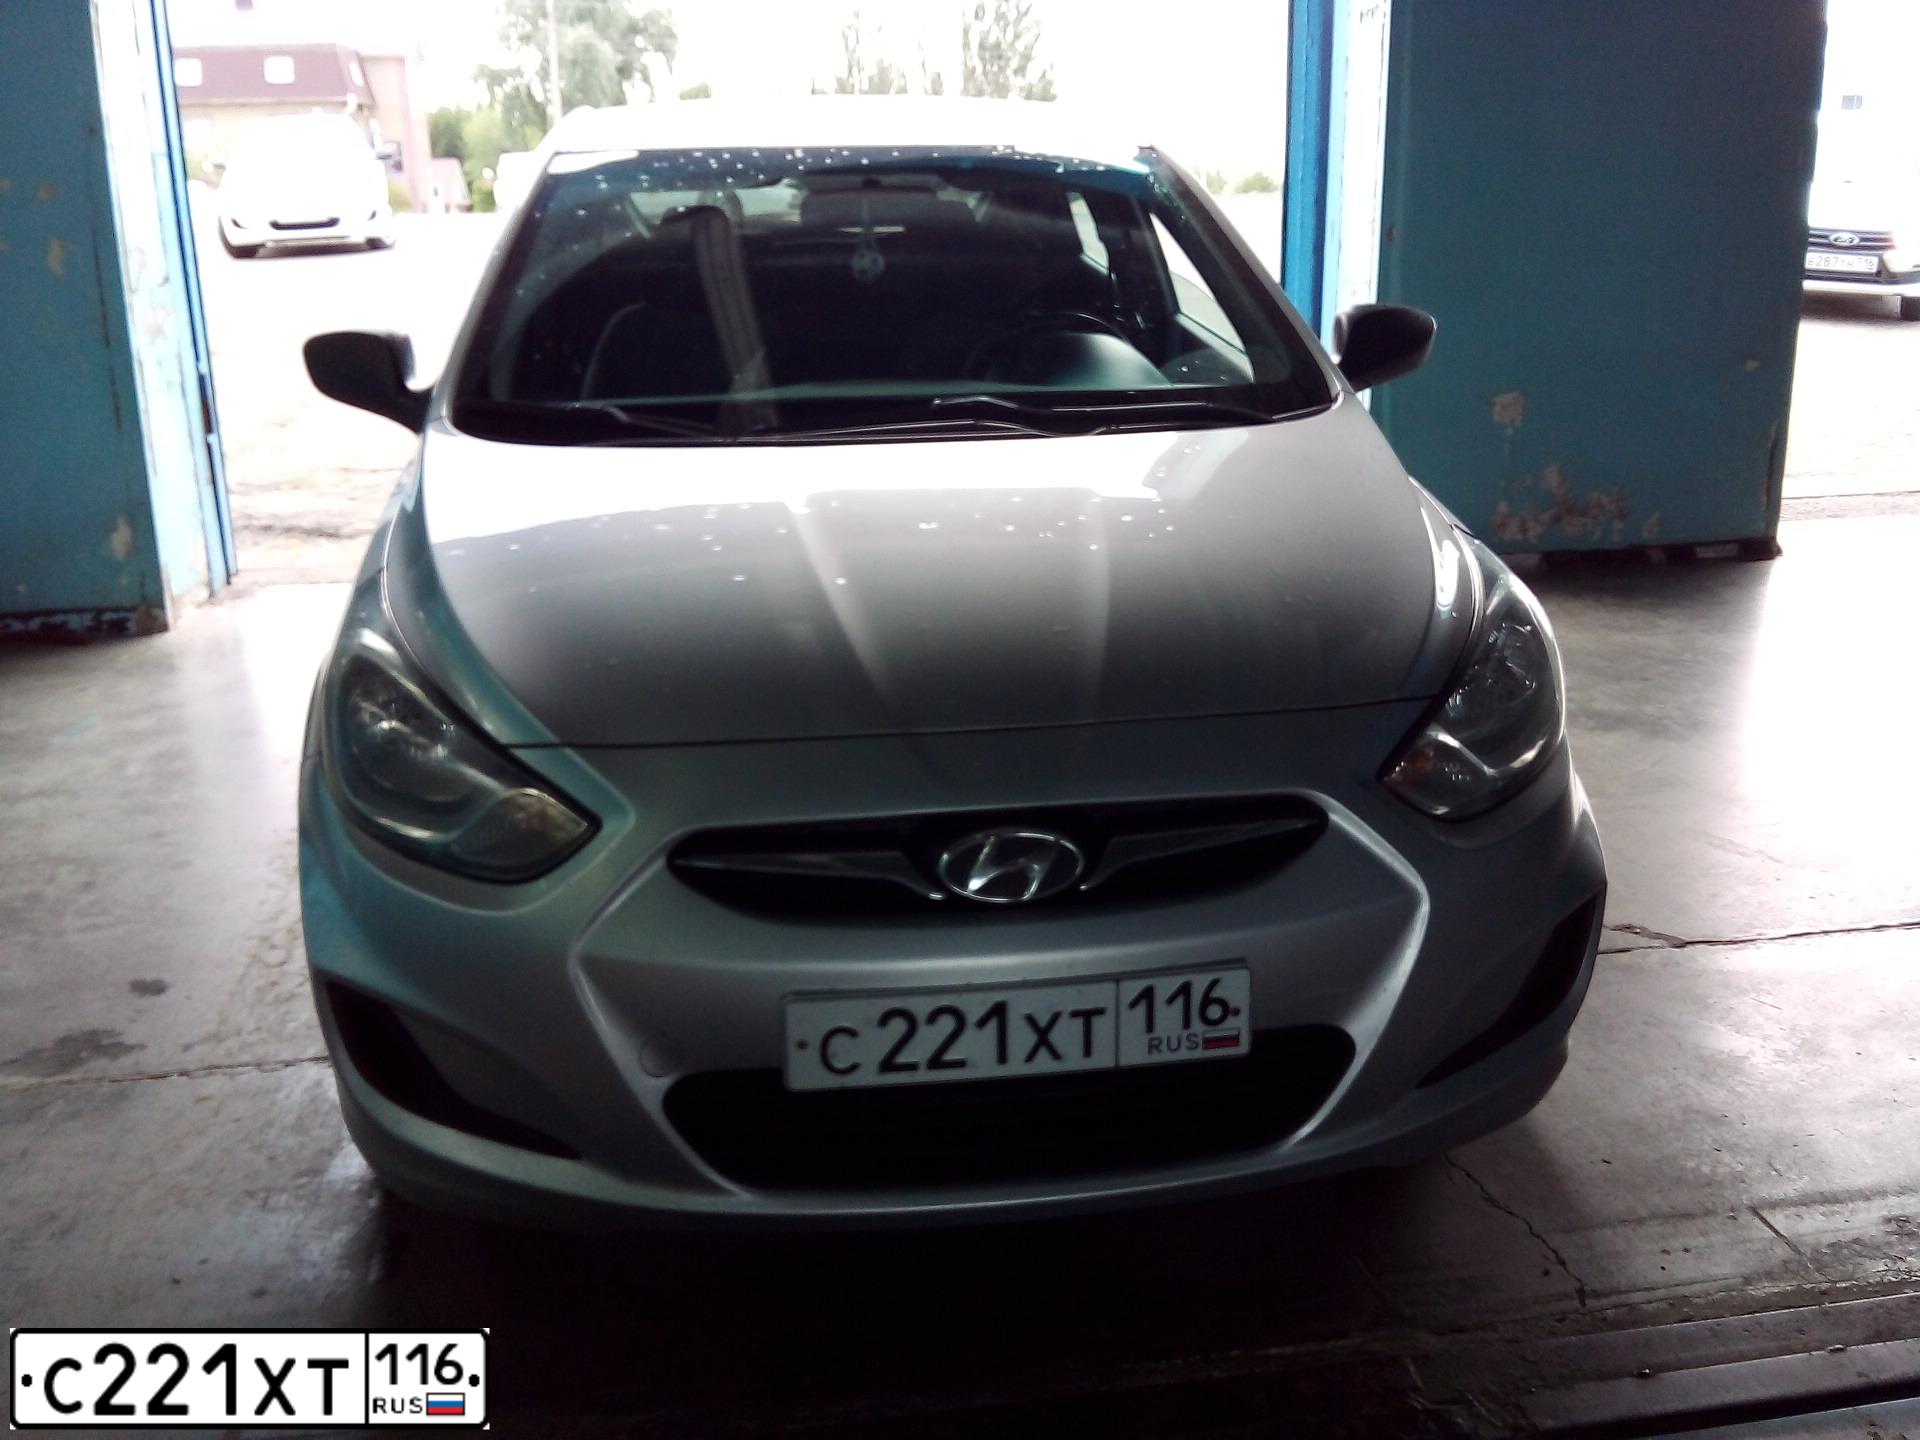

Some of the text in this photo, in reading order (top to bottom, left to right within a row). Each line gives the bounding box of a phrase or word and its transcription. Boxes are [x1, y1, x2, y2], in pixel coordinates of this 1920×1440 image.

[820, 977, 1231, 1074] C221XT 116
[1147, 1032, 1200, 1055] RUS
